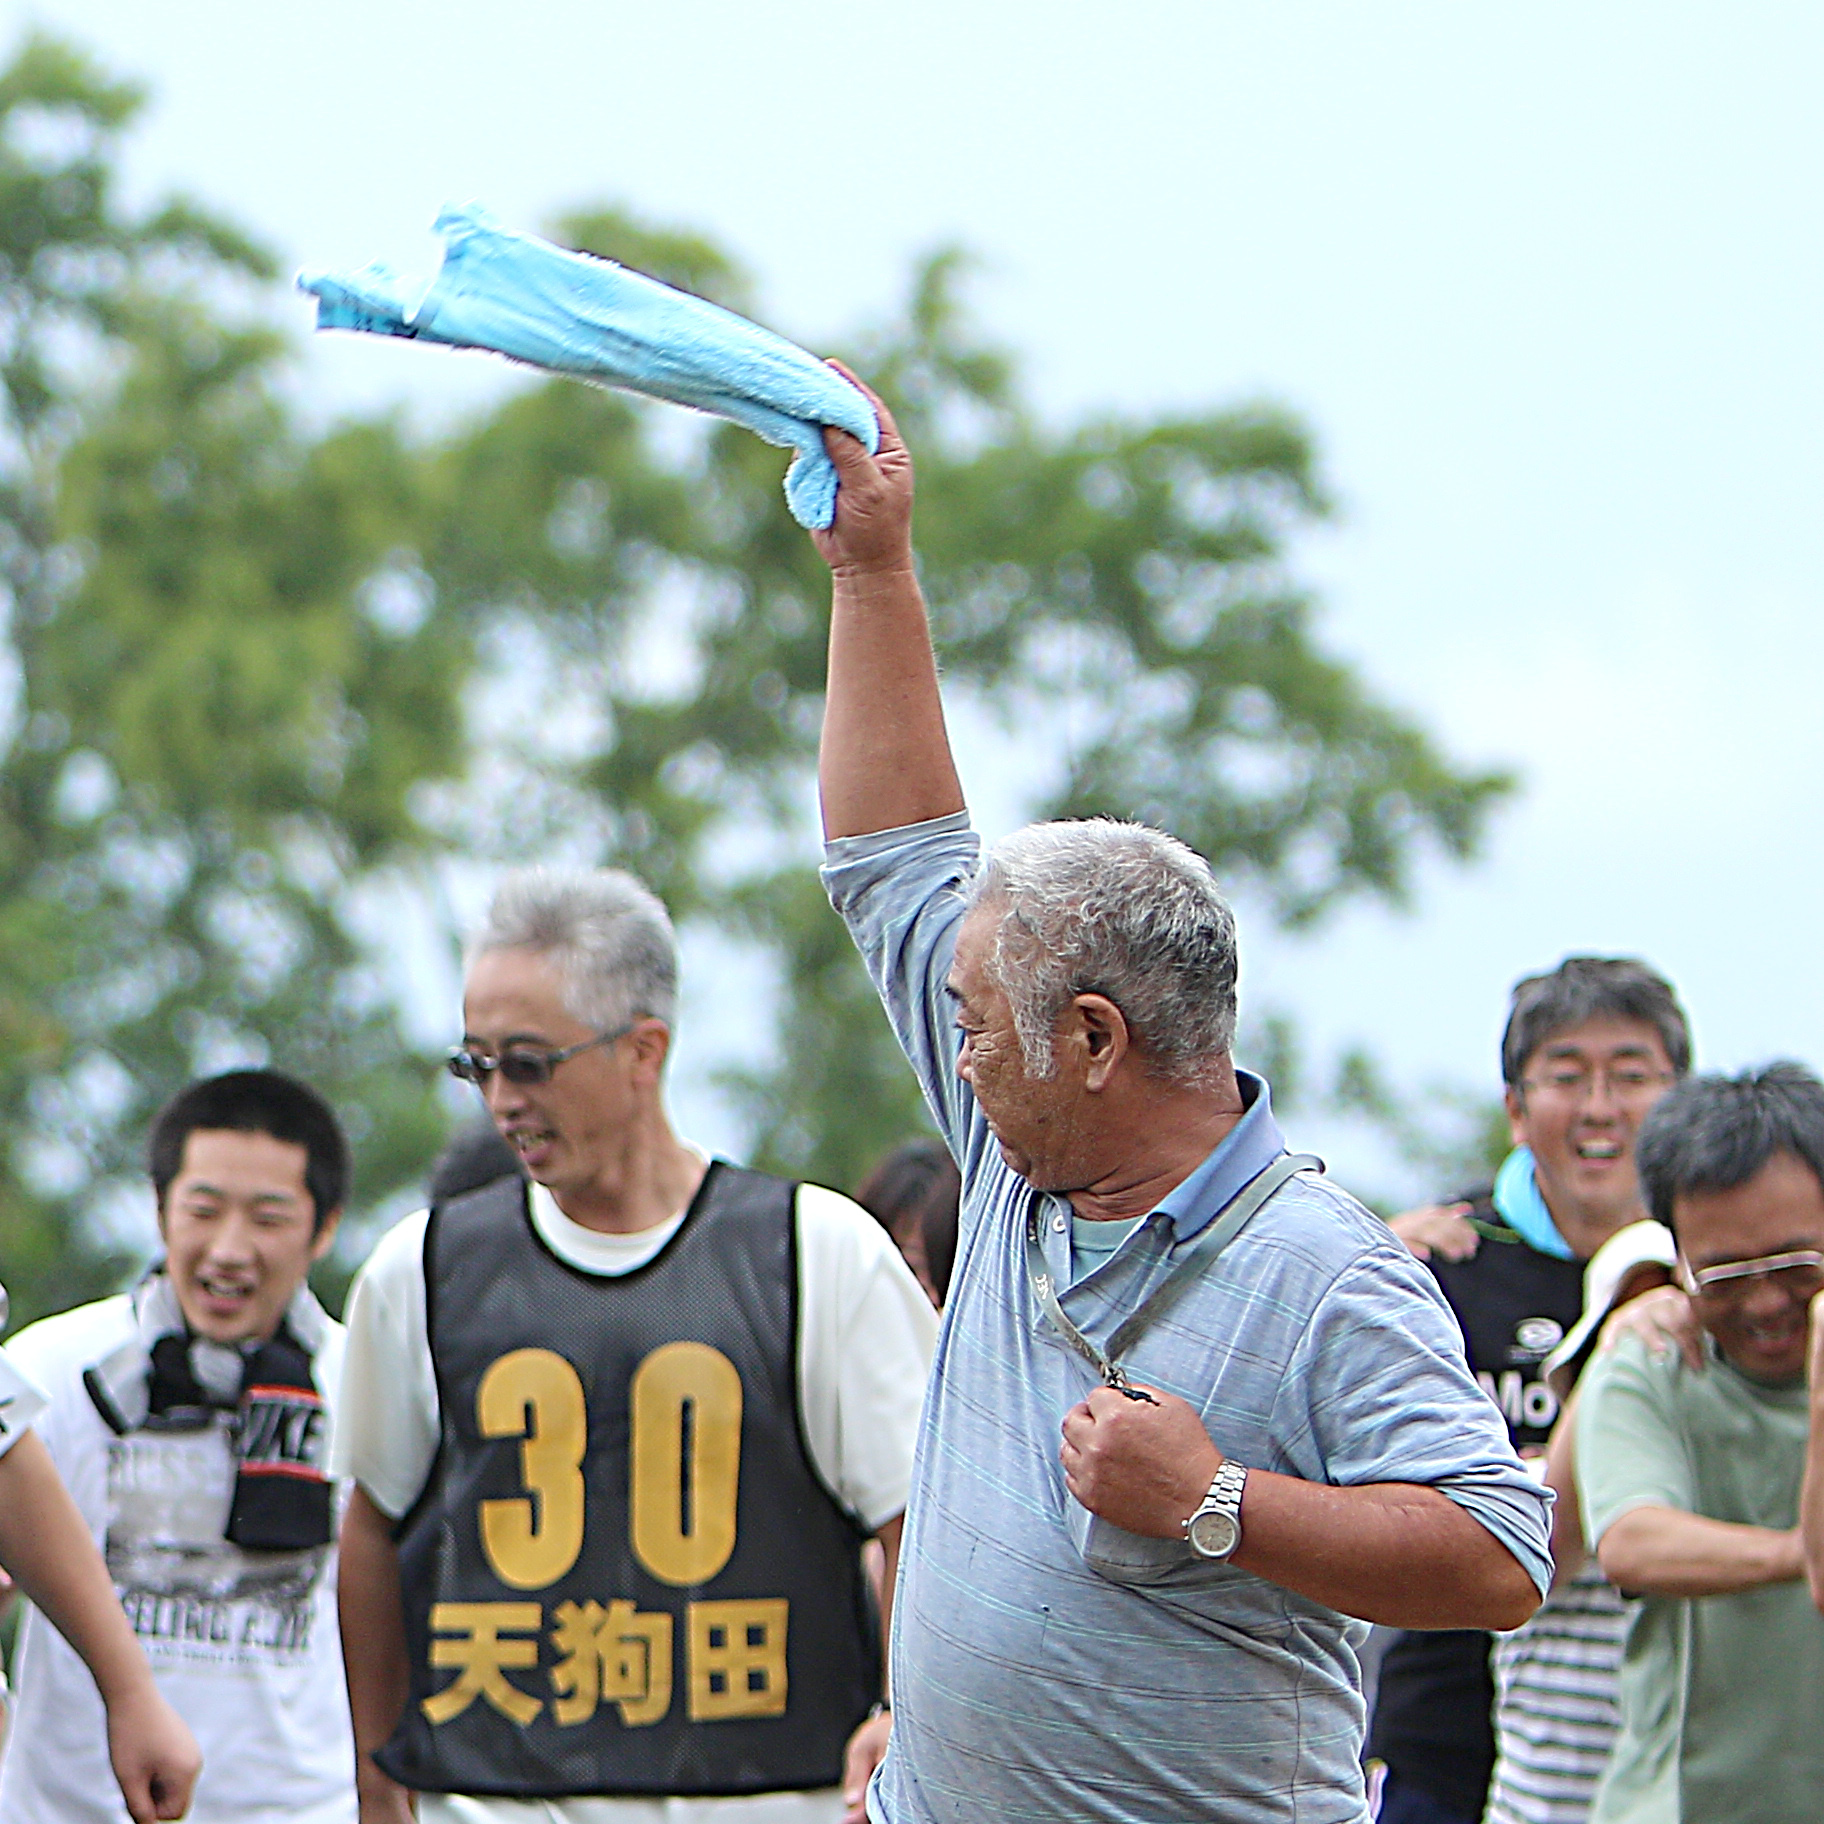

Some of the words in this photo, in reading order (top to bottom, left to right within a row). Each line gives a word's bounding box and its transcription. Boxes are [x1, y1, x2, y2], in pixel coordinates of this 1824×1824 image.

[1035, 1273, 1049, 1300] NEC
[478, 1341, 743, 1591] 30
[420, 1598, 789, 1727] 天狗田
